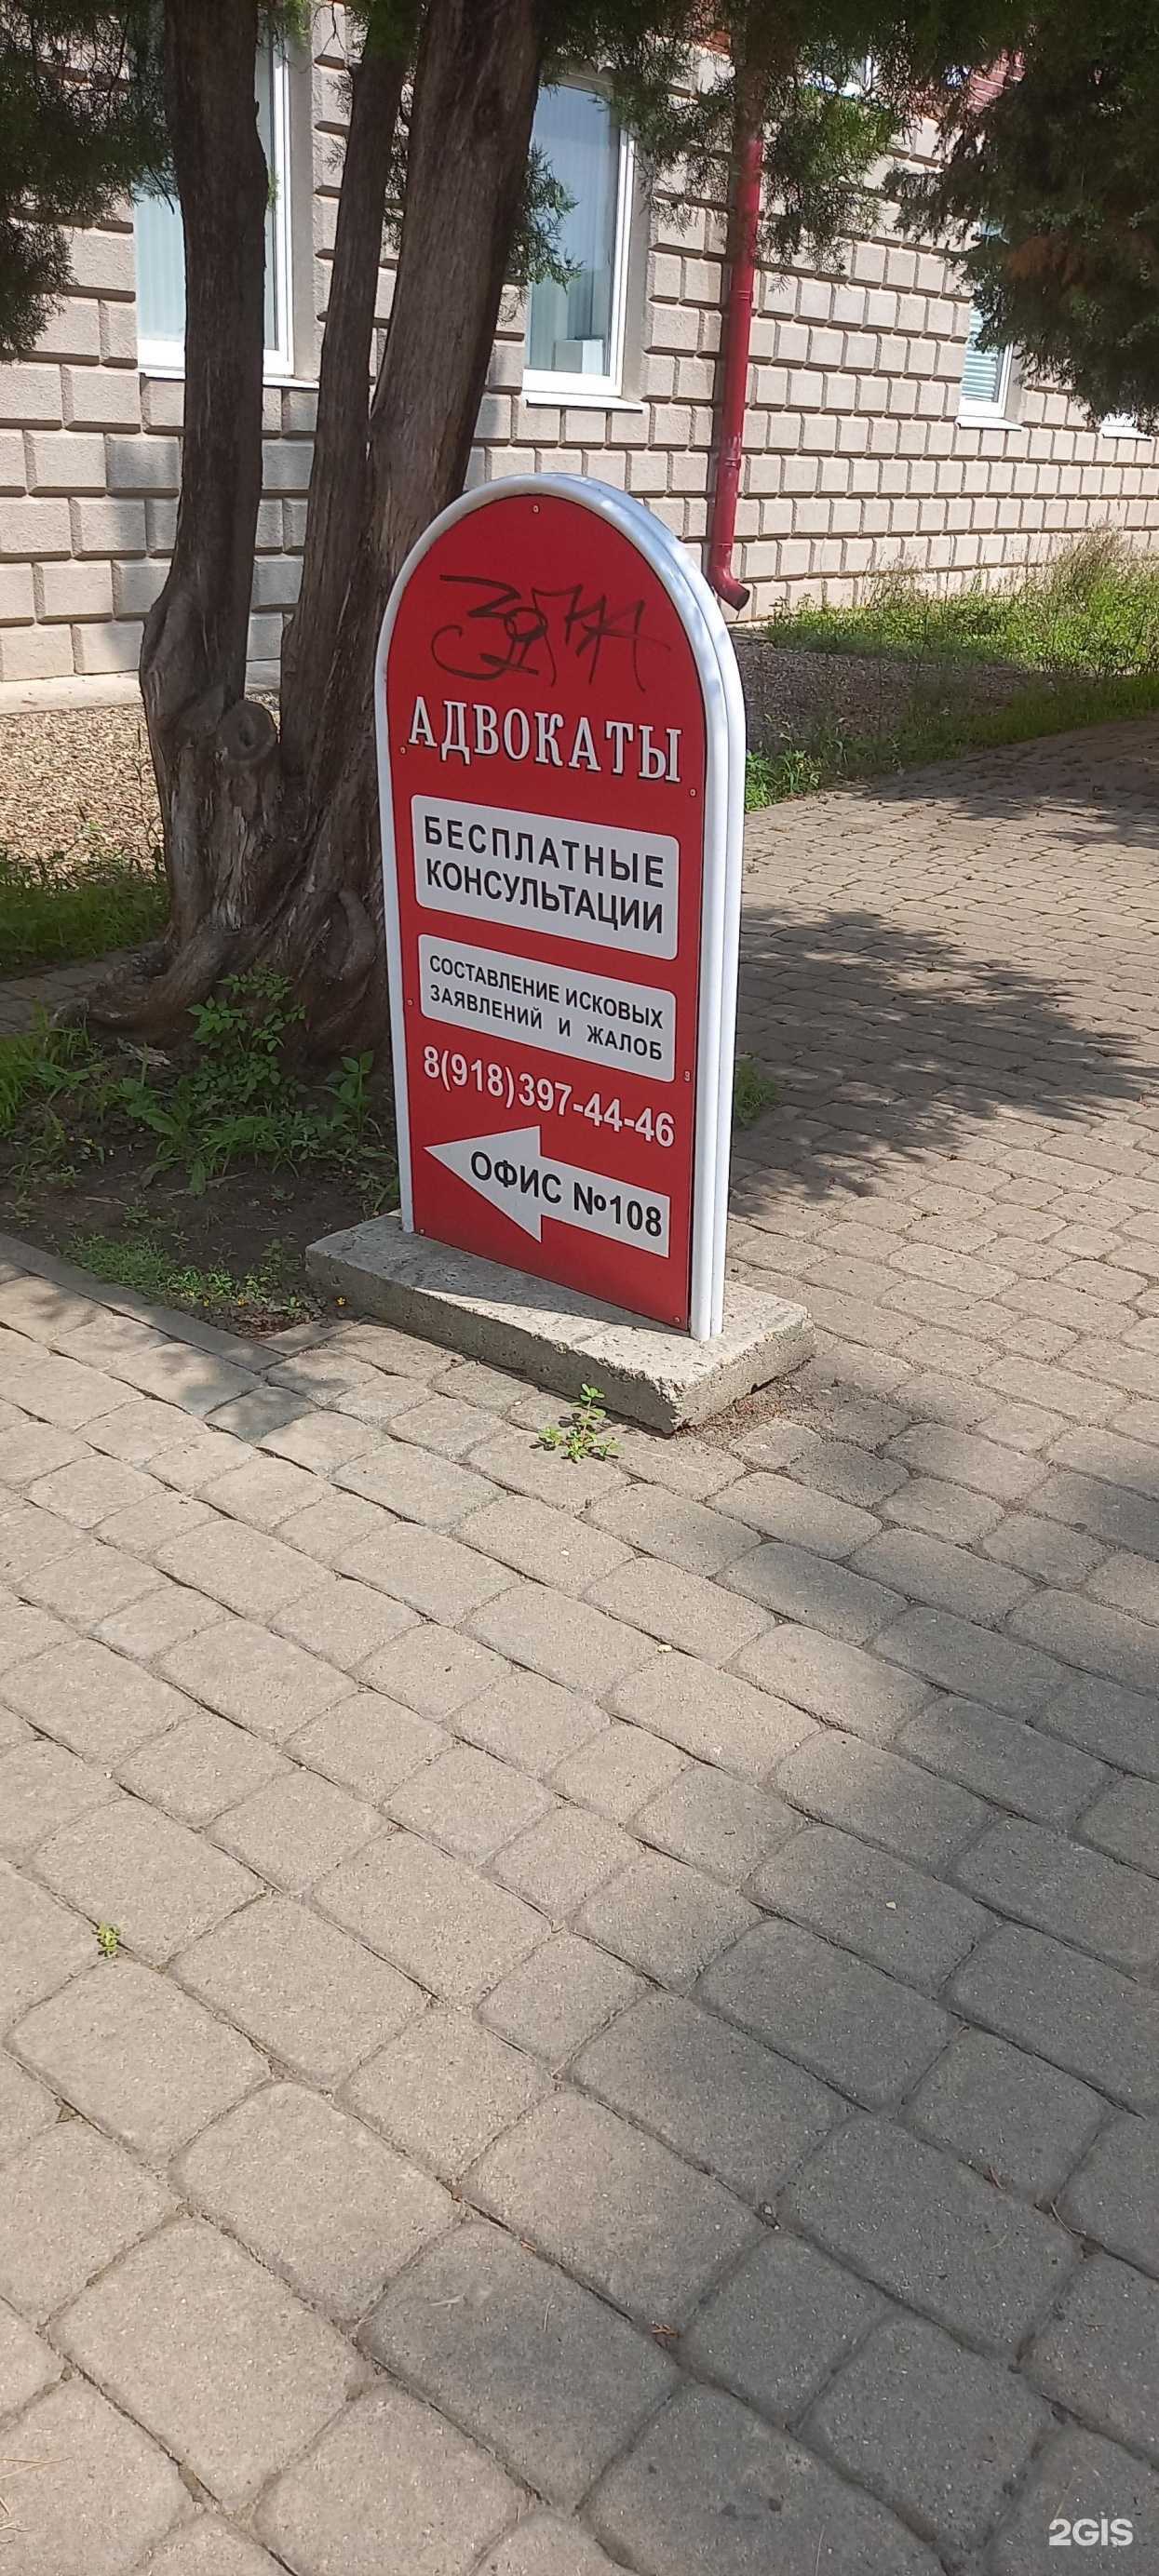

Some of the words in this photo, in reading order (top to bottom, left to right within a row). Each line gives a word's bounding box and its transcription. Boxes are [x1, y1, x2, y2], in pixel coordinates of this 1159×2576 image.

[408, 695, 682, 784] АДВОКАТЫ
[424, 815, 665, 889] БЕСПЛАТНЫЕ
[425, 857, 664, 934] КОНСУЛЬТАЦИИ
[429, 955, 559, 1003] СОСТАВЛЕНИЕ
[565, 989, 664, 1030] ИСКОВЫХ
[429, 985, 543, 1030] ЗАЯВЛЕНИЙ
[558, 1017, 572, 1038] И
[586, 1024, 663, 1061] ЖАЛОБ
[423, 1045, 676, 1148] 8(918)397-44-46
[470, 1150, 562, 1204] ОФИС
[573, 1182, 663, 1238] №108
